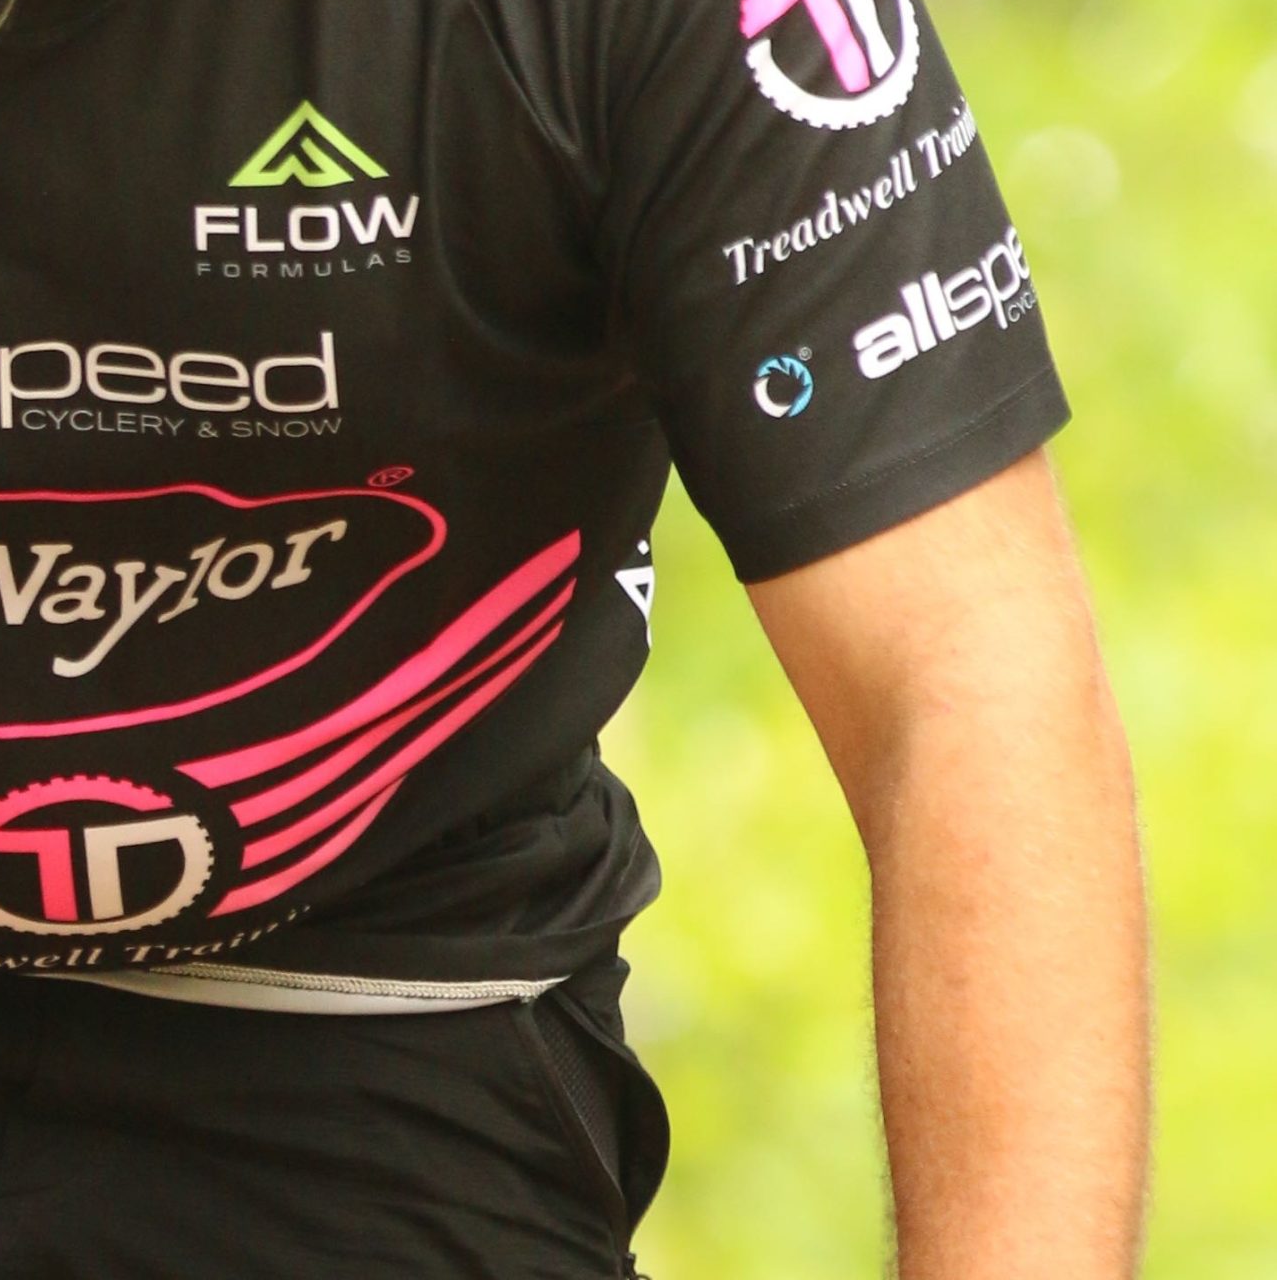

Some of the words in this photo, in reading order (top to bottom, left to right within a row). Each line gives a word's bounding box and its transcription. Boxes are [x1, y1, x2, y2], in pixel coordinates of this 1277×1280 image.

[194, 192, 420, 252] FLOW
[722, 148, 919, 286] Treadwell
[196, 249, 412, 278] FORMULAS
[853, 225, 1030, 380] allspe
[21, 409, 185, 437] CYCLERY
[197, 420, 219, 439] &
[231, 417, 343, 439] SNOW
